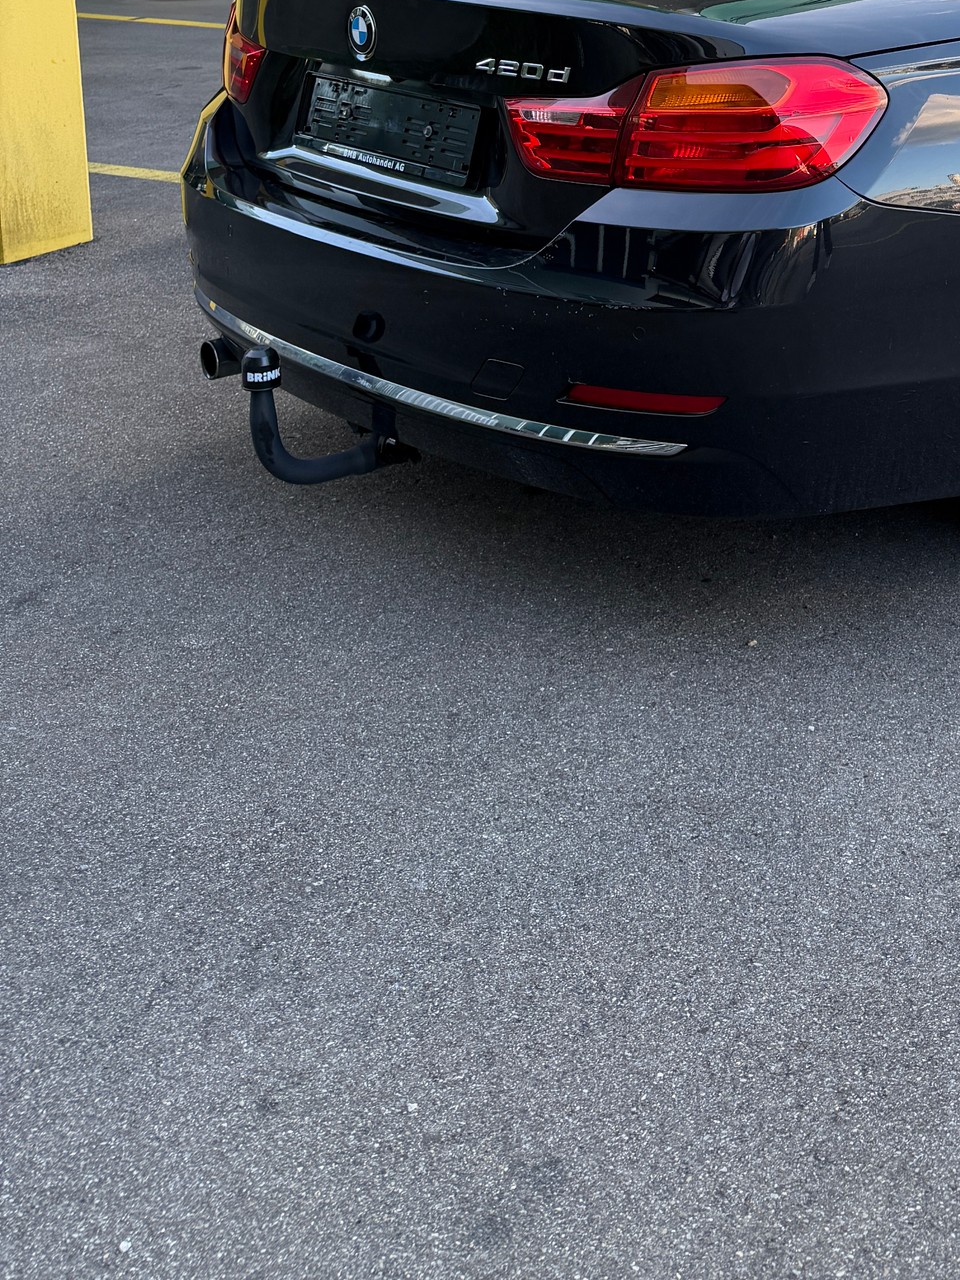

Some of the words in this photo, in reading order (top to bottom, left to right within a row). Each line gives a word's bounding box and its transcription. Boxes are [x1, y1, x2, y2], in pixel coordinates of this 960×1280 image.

[475, 58, 571, 83] 420d
[358, 153, 394, 169] Autohandel
[394, 160, 405, 172] AG
